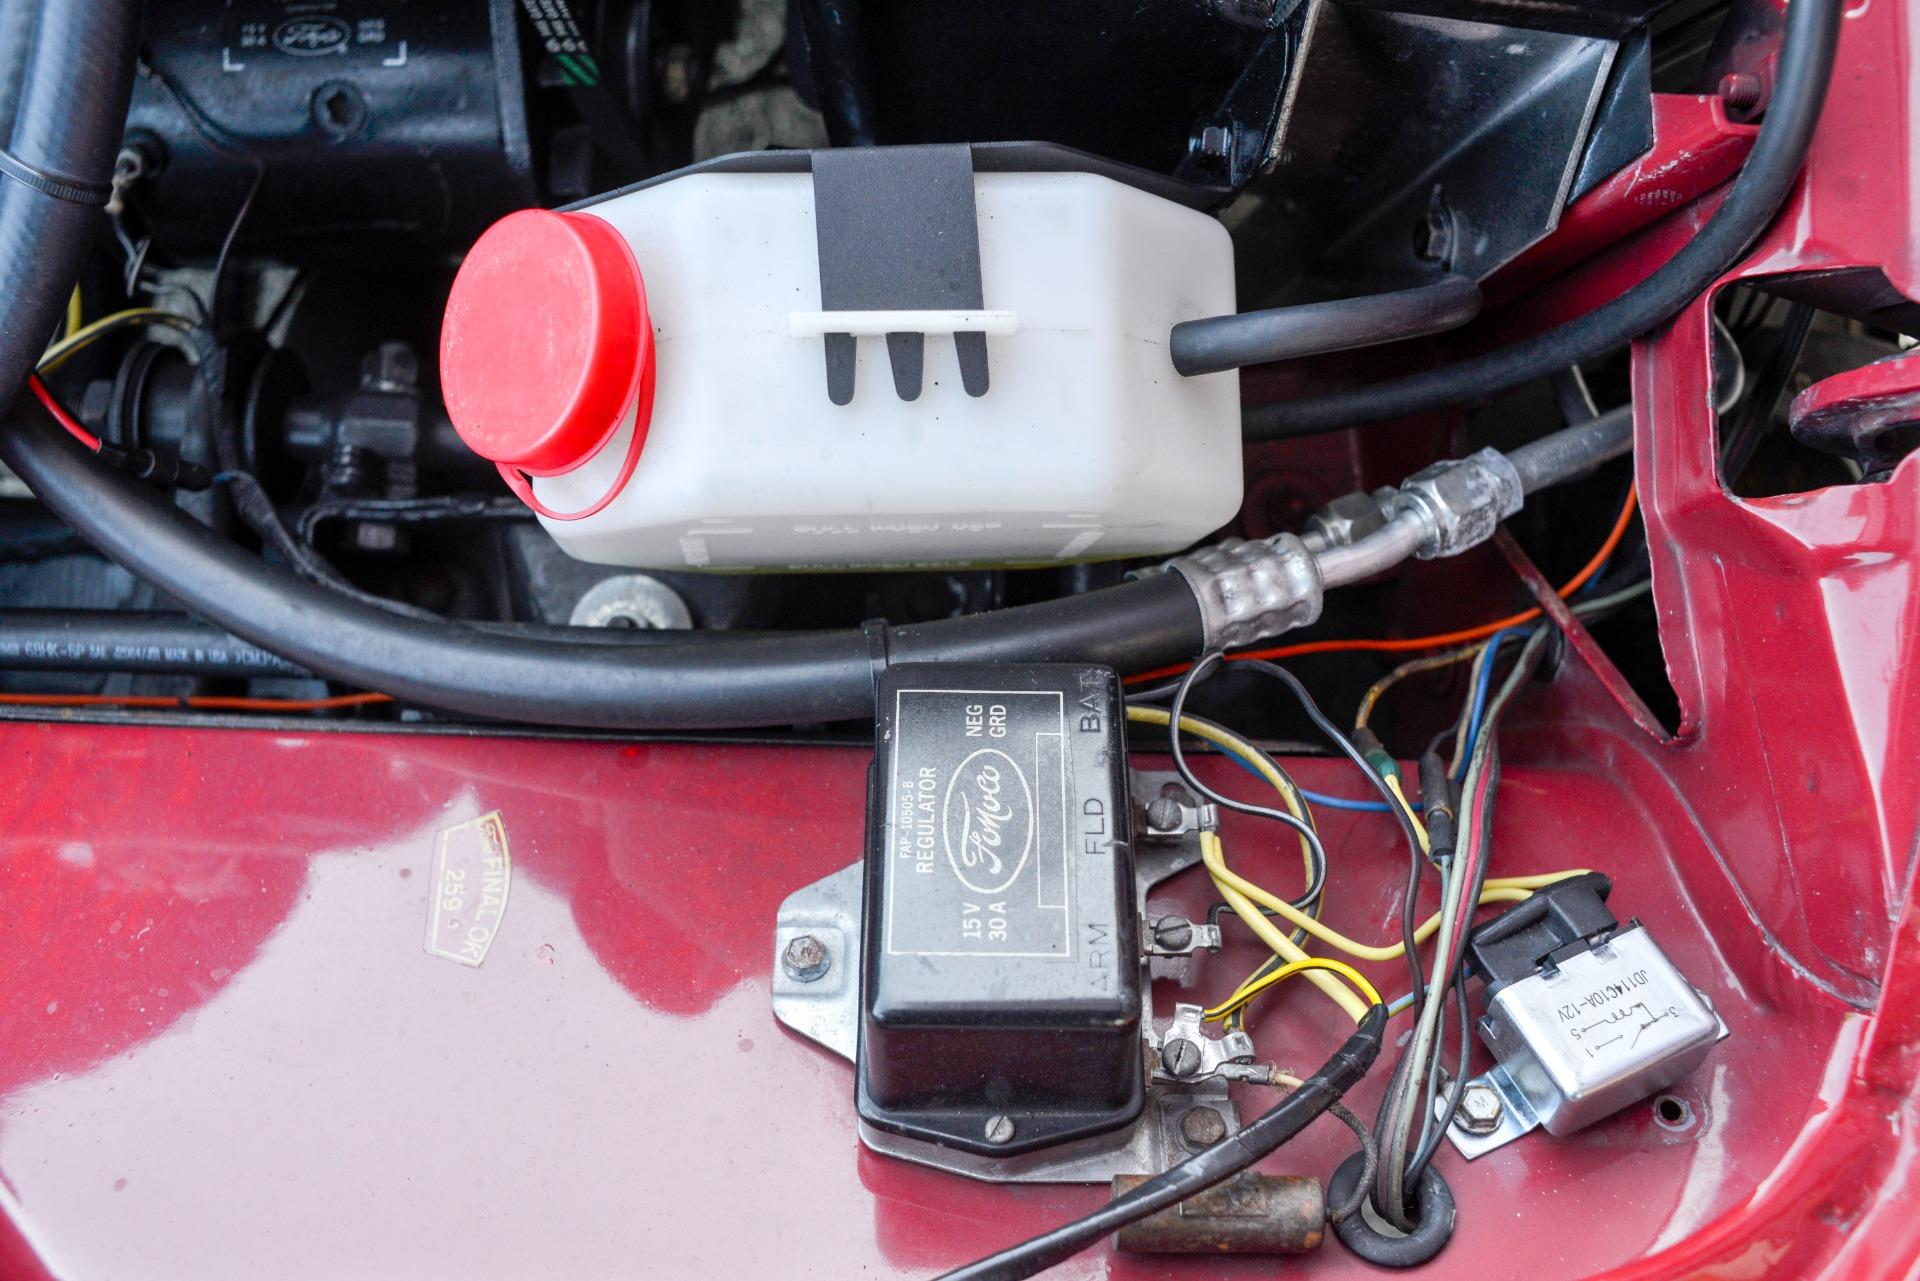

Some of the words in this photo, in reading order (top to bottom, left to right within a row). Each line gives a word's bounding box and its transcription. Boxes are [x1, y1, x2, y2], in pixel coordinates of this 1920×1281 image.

[1079, 672, 1102, 733] BAT
[965, 704, 983, 737] NEG
[989, 704, 1007, 738] GRD
[900, 780, 914, 859] FAP-10505-B
[916, 766, 937, 874] REGULATOR
[961, 764, 1014, 875] FoMoCo
[1083, 798, 1106, 855] FLD
[442, 869, 466, 911] 259
[475, 856, 503, 921] FINAL
[963, 902, 981, 915] V
[989, 901, 1007, 915] A
[461, 925, 490, 958] OK
[963, 917, 982, 940] 15
[988, 918, 1007, 941] 30
[1090, 922, 1110, 992] ARM
[1668, 1006, 1680, 1018] 3
[1570, 1028, 1582, 1040] 5
